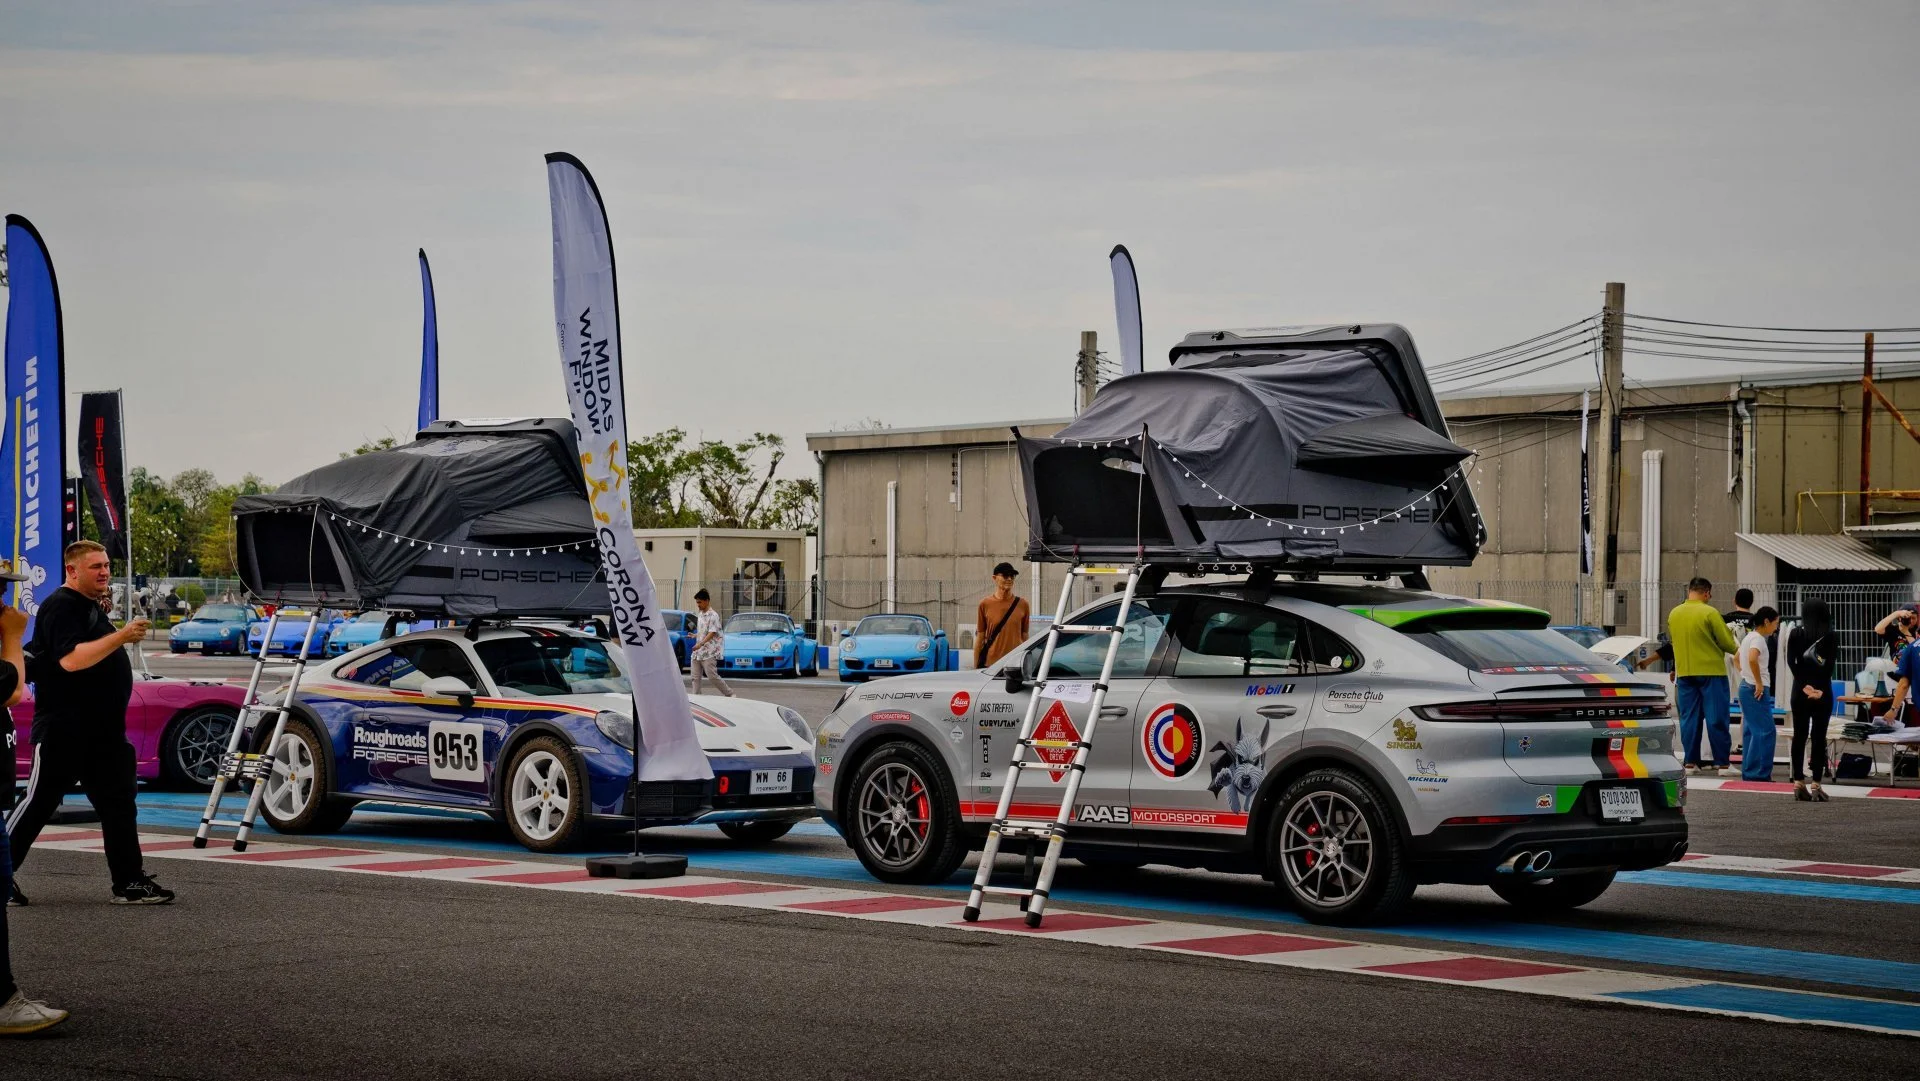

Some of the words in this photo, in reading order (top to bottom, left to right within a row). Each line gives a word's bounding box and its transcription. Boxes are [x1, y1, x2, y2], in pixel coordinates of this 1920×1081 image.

[579, 307, 602, 436] WINDOW
[594, 338, 614, 433] MIDAS
[1302, 505, 1430, 524] PORSCHE
[460, 568, 592, 584] PORSCHE
[599, 526, 656, 642] CORONA
[1245, 684, 1283, 697] Mobil
[1328, 690, 1362, 700] Porsche
[1363, 691, 1384, 701] Club
[952, 697, 968, 707] Leica
[1576, 708, 1643, 717] PORSCHE
[354, 726, 427, 748] Roughroads
[433, 731, 479, 772] 953
[1386, 741, 1423, 750] SINGHA
[353, 749, 428, 765] PORSCHE
[820, 756, 832, 764] TAG
[777, 771, 788, 783] 66
[1079, 805, 1130, 823] AAS
[1133, 811, 1217, 824] MOTORSPORT
